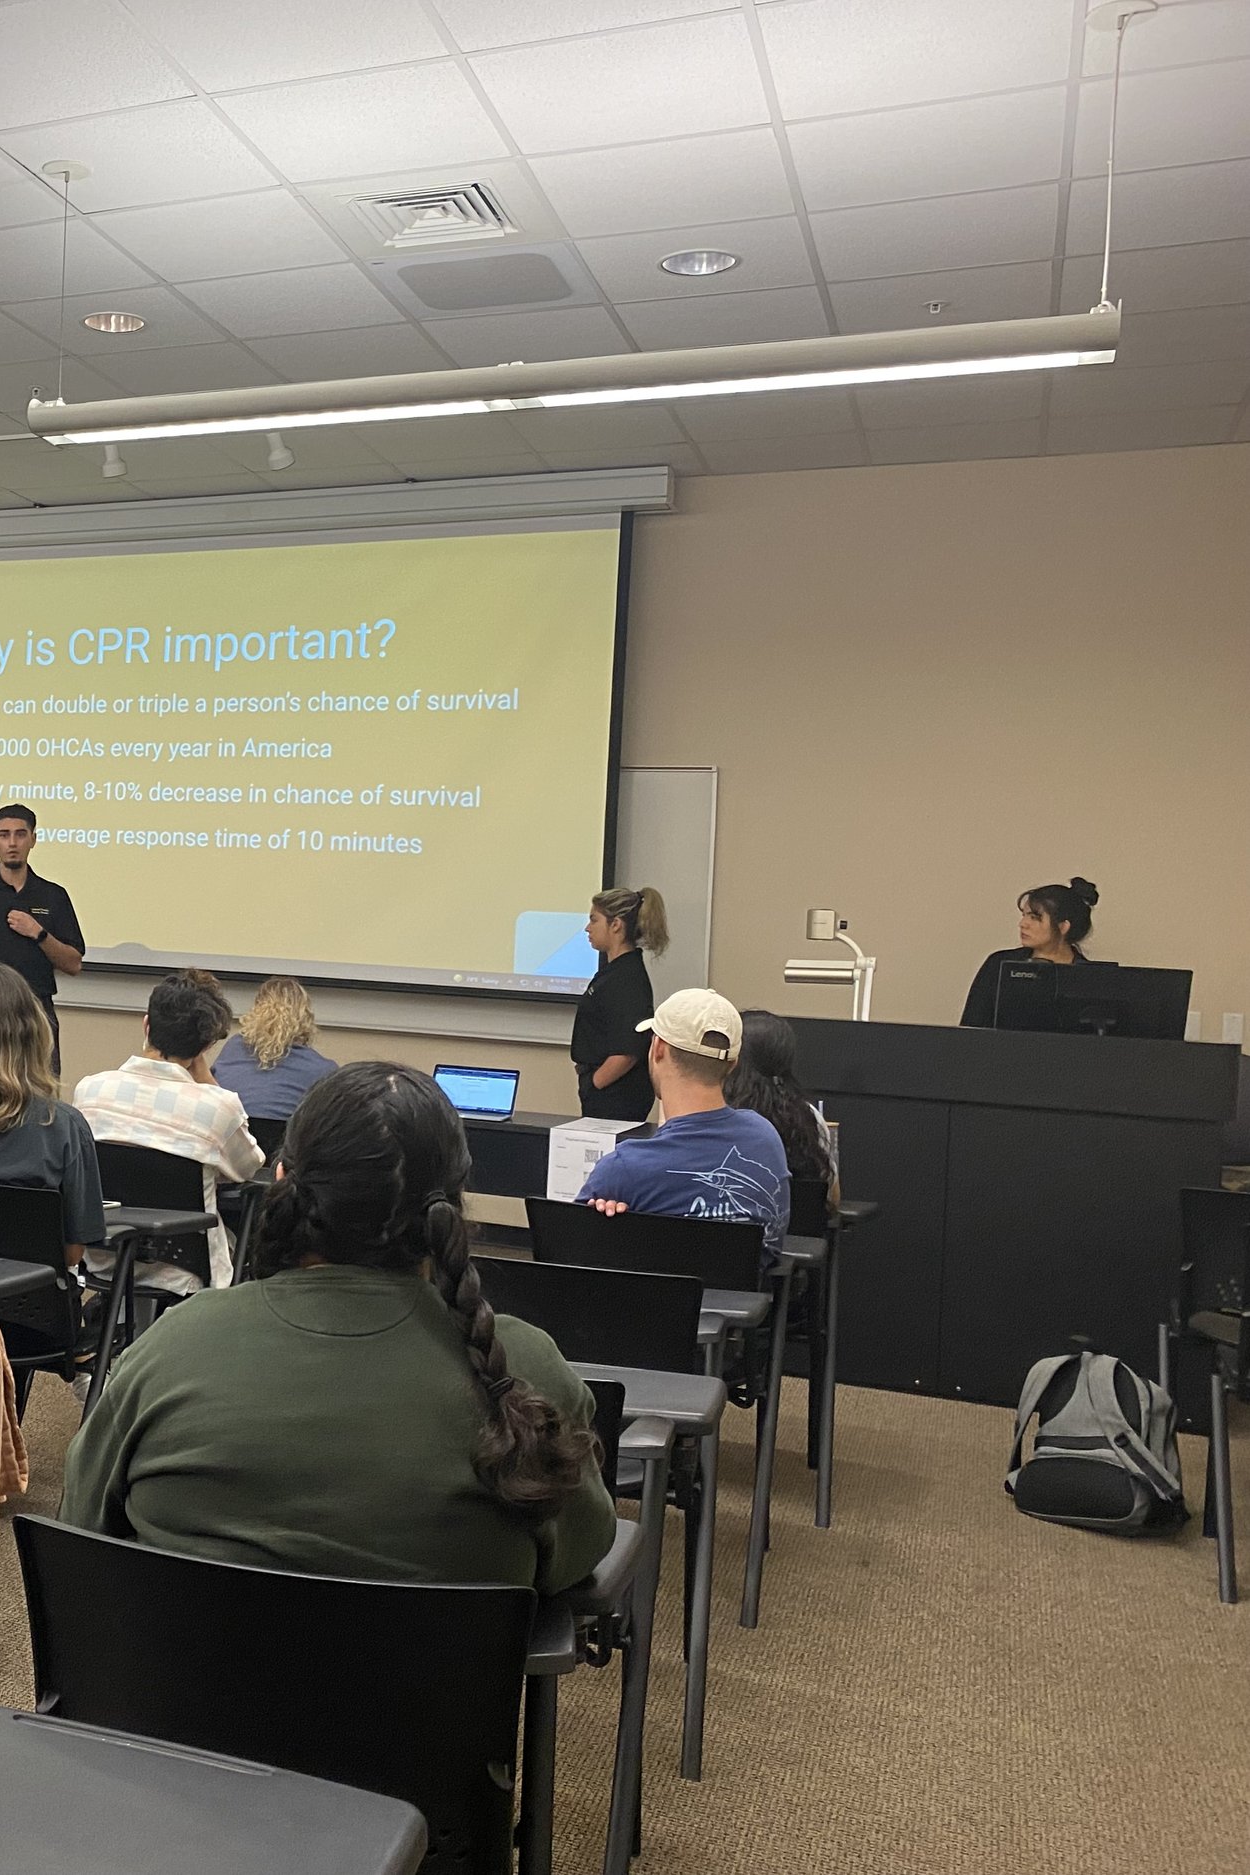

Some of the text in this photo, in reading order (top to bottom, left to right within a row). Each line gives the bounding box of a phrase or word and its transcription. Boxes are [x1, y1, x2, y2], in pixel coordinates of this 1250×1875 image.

[25, 630, 56, 666] is
[68, 627, 150, 665] CPR
[163, 618, 396, 672] important?
[3, 699, 36, 714] can
[42, 694, 107, 714] double
[113, 698, 133, 713] or
[139, 693, 189, 717] triple
[195, 697, 207, 713] a
[308, 691, 390, 712] chance
[396, 689, 421, 711] of
[426, 687, 519, 711] survival
[36, 738, 105, 757] OHCAs
[110, 742, 163, 762] every
[168, 742, 212, 762] year
[218, 738, 236, 757] in
[242, 738, 332, 758] America
[9, 781, 78, 803] minute,
[84, 781, 143, 801] 8-10%
[149, 781, 242, 803] decrease
[249, 783, 267, 803] in
[273, 783, 353, 804] chance
[359, 783, 384, 805] of
[389, 785, 481, 808] survival
[36, 828, 110, 848] average
[116, 829, 209, 850] response
[215, 828, 261, 849] time
[267, 828, 291, 849] of
[297, 830, 323, 850] 10
[330, 831, 423, 854] minutes
